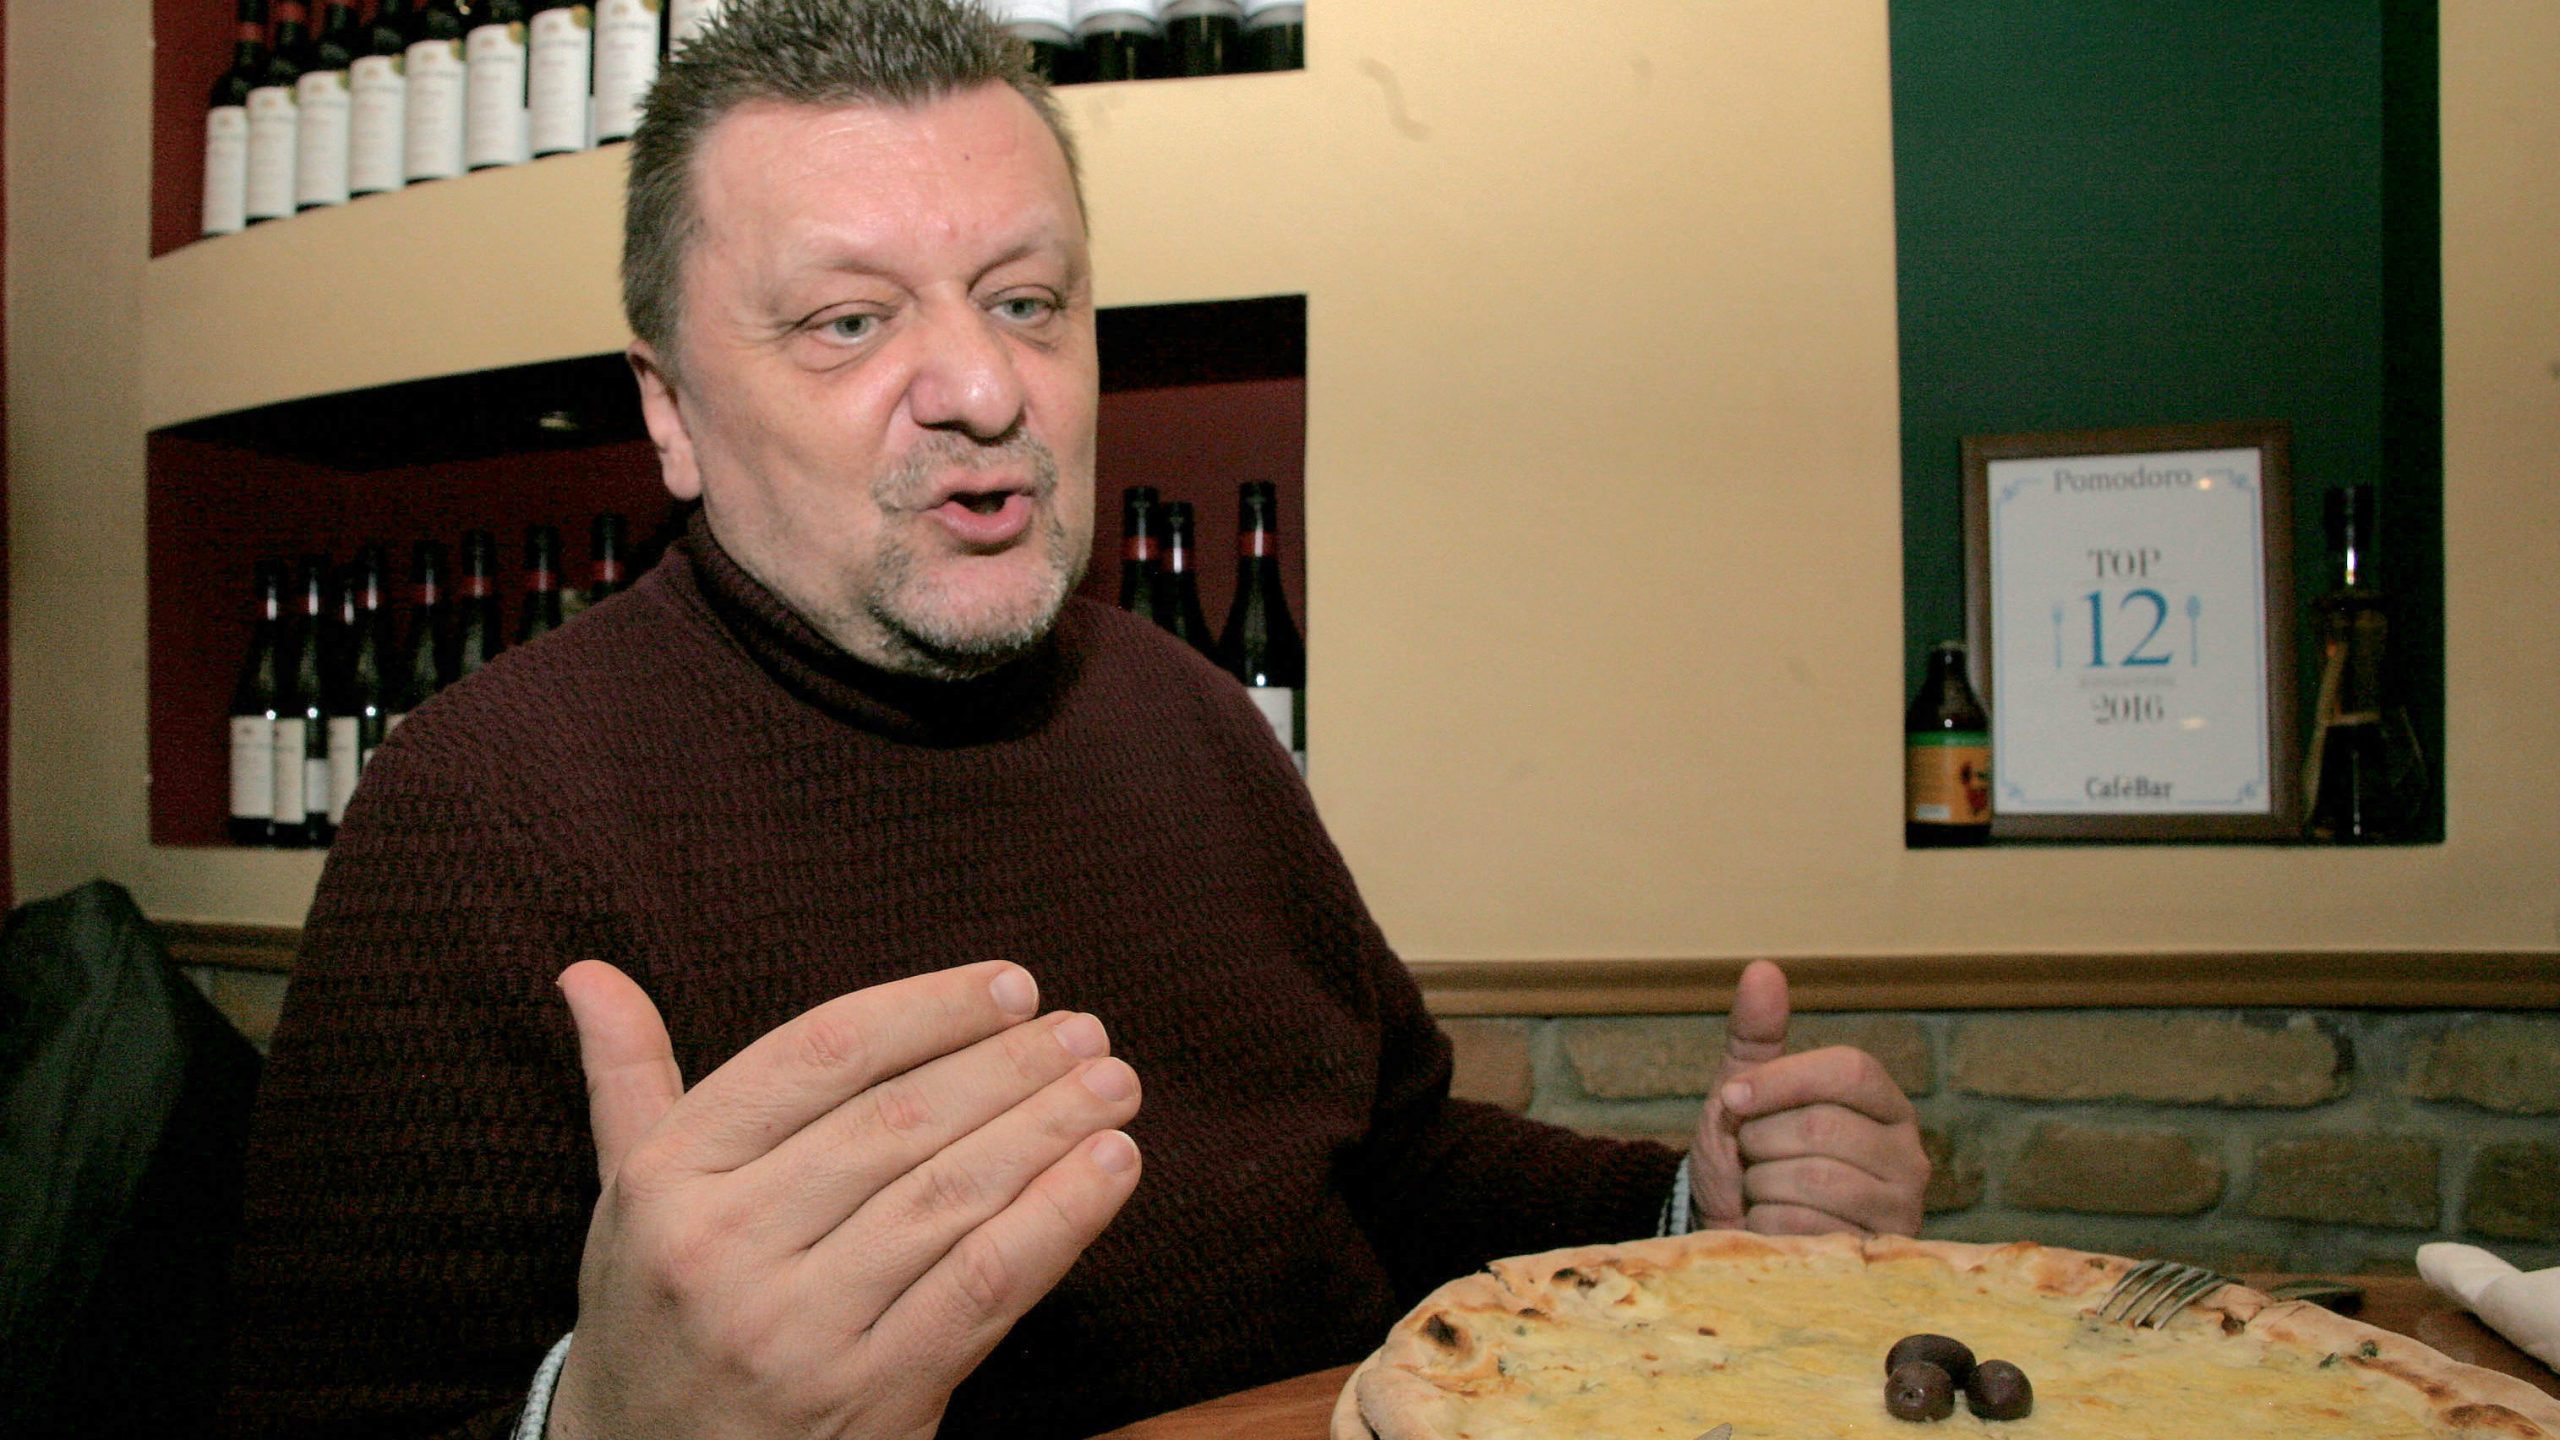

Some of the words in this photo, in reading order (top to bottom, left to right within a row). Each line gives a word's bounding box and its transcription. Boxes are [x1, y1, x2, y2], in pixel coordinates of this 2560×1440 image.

[2053, 464, 2193, 492] Pomodoro
[2088, 549, 2162, 578] TOP
[2084, 587, 2174, 668] 12
[2091, 695, 2165, 724] 2016
